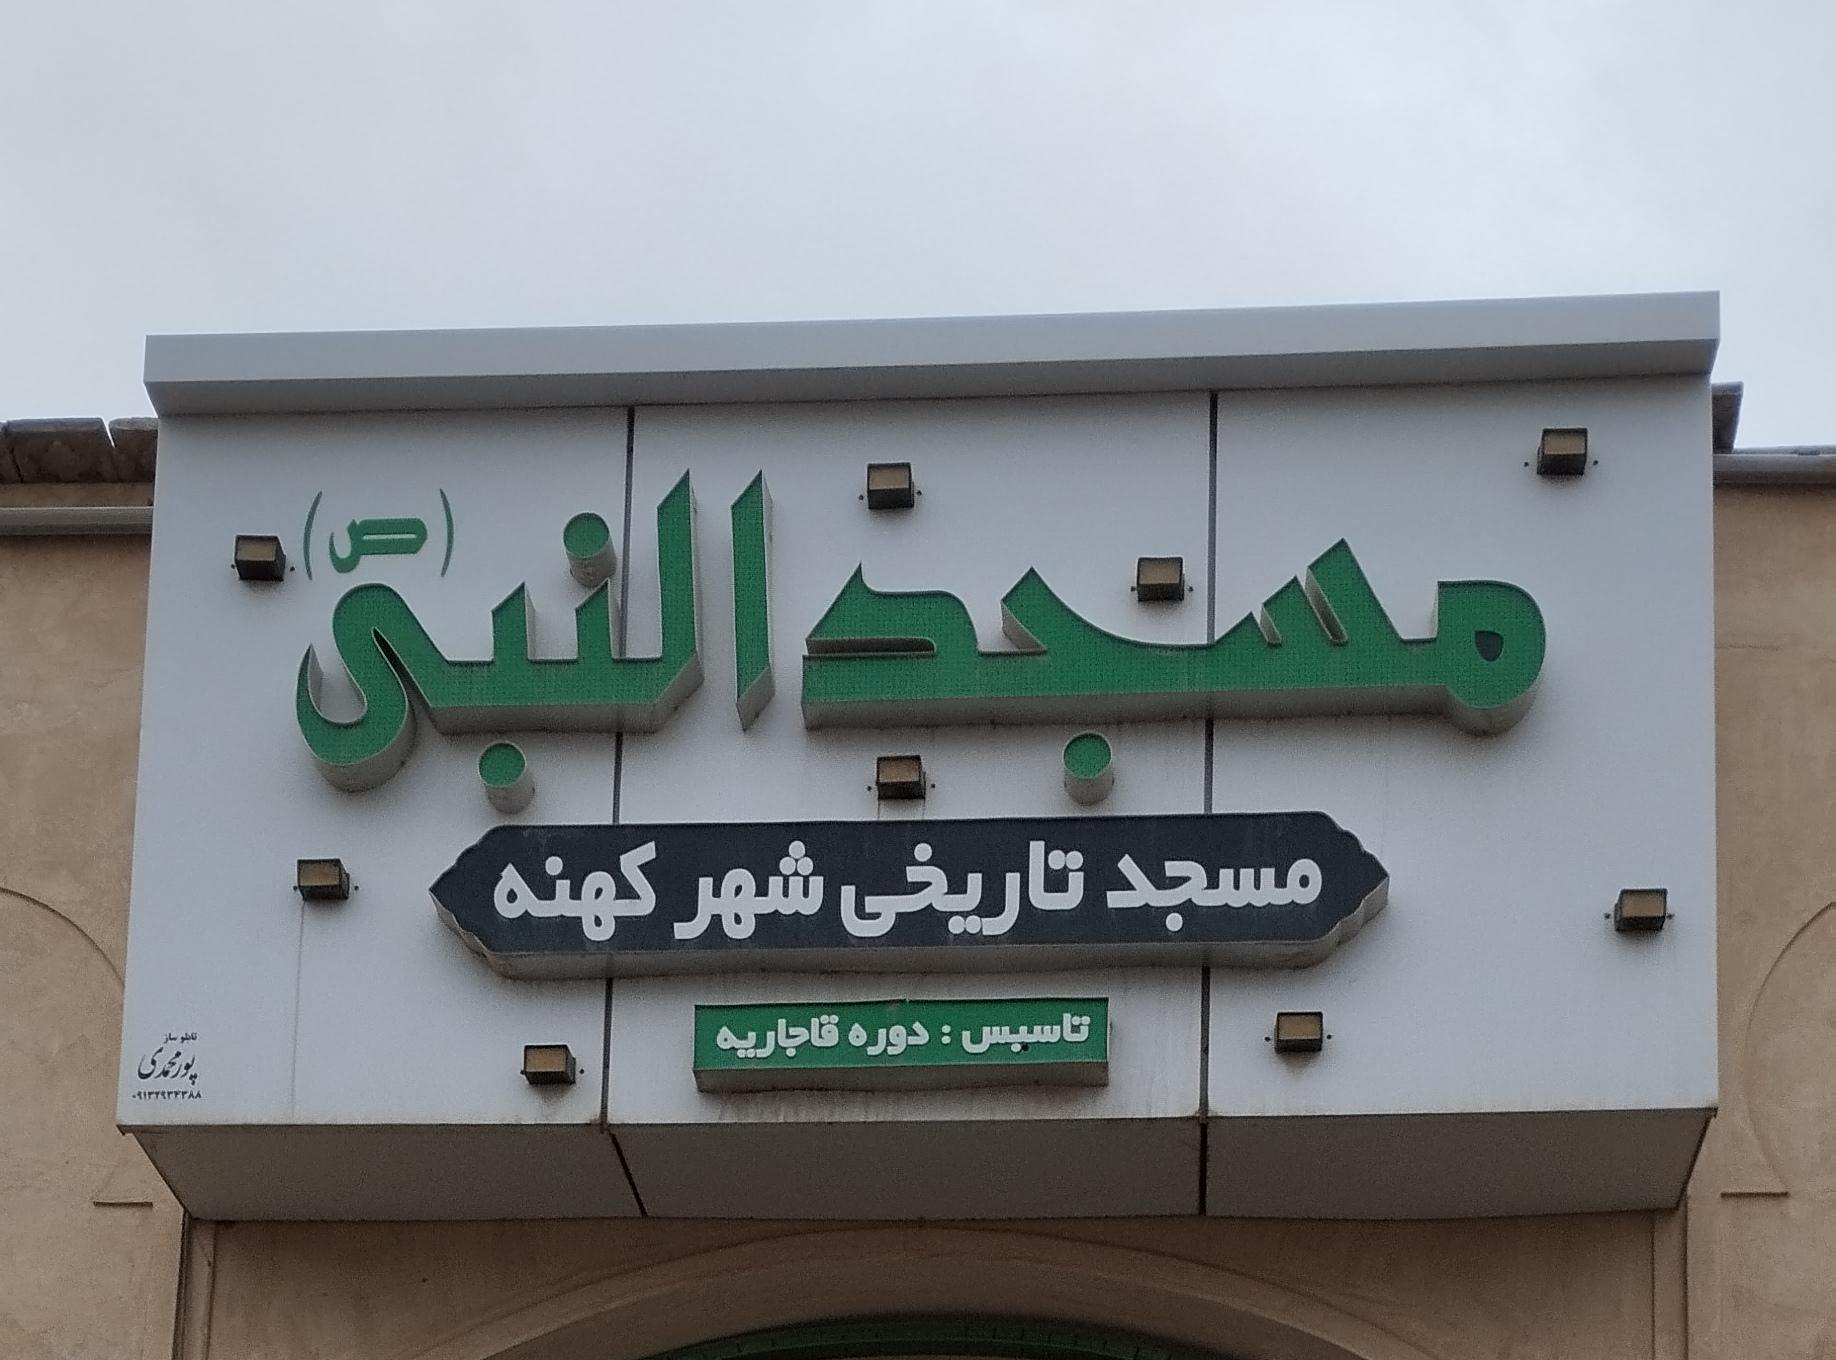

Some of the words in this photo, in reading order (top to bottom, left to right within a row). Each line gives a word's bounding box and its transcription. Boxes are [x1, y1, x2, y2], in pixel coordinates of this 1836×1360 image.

[303, 488, 455, 579] (ص)
[296, 468, 772, 789] النبی
[802, 537, 1548, 780] مسجد
[493, 840, 657, 942] کهنه
[673, 840, 825, 941] شهر
[840, 840, 1085, 937] تاریخی
[1105, 854, 1323, 933] مسجد
[715, 1014, 839, 1058] قاجاریه
[848, 1021, 930, 1056] دوره
